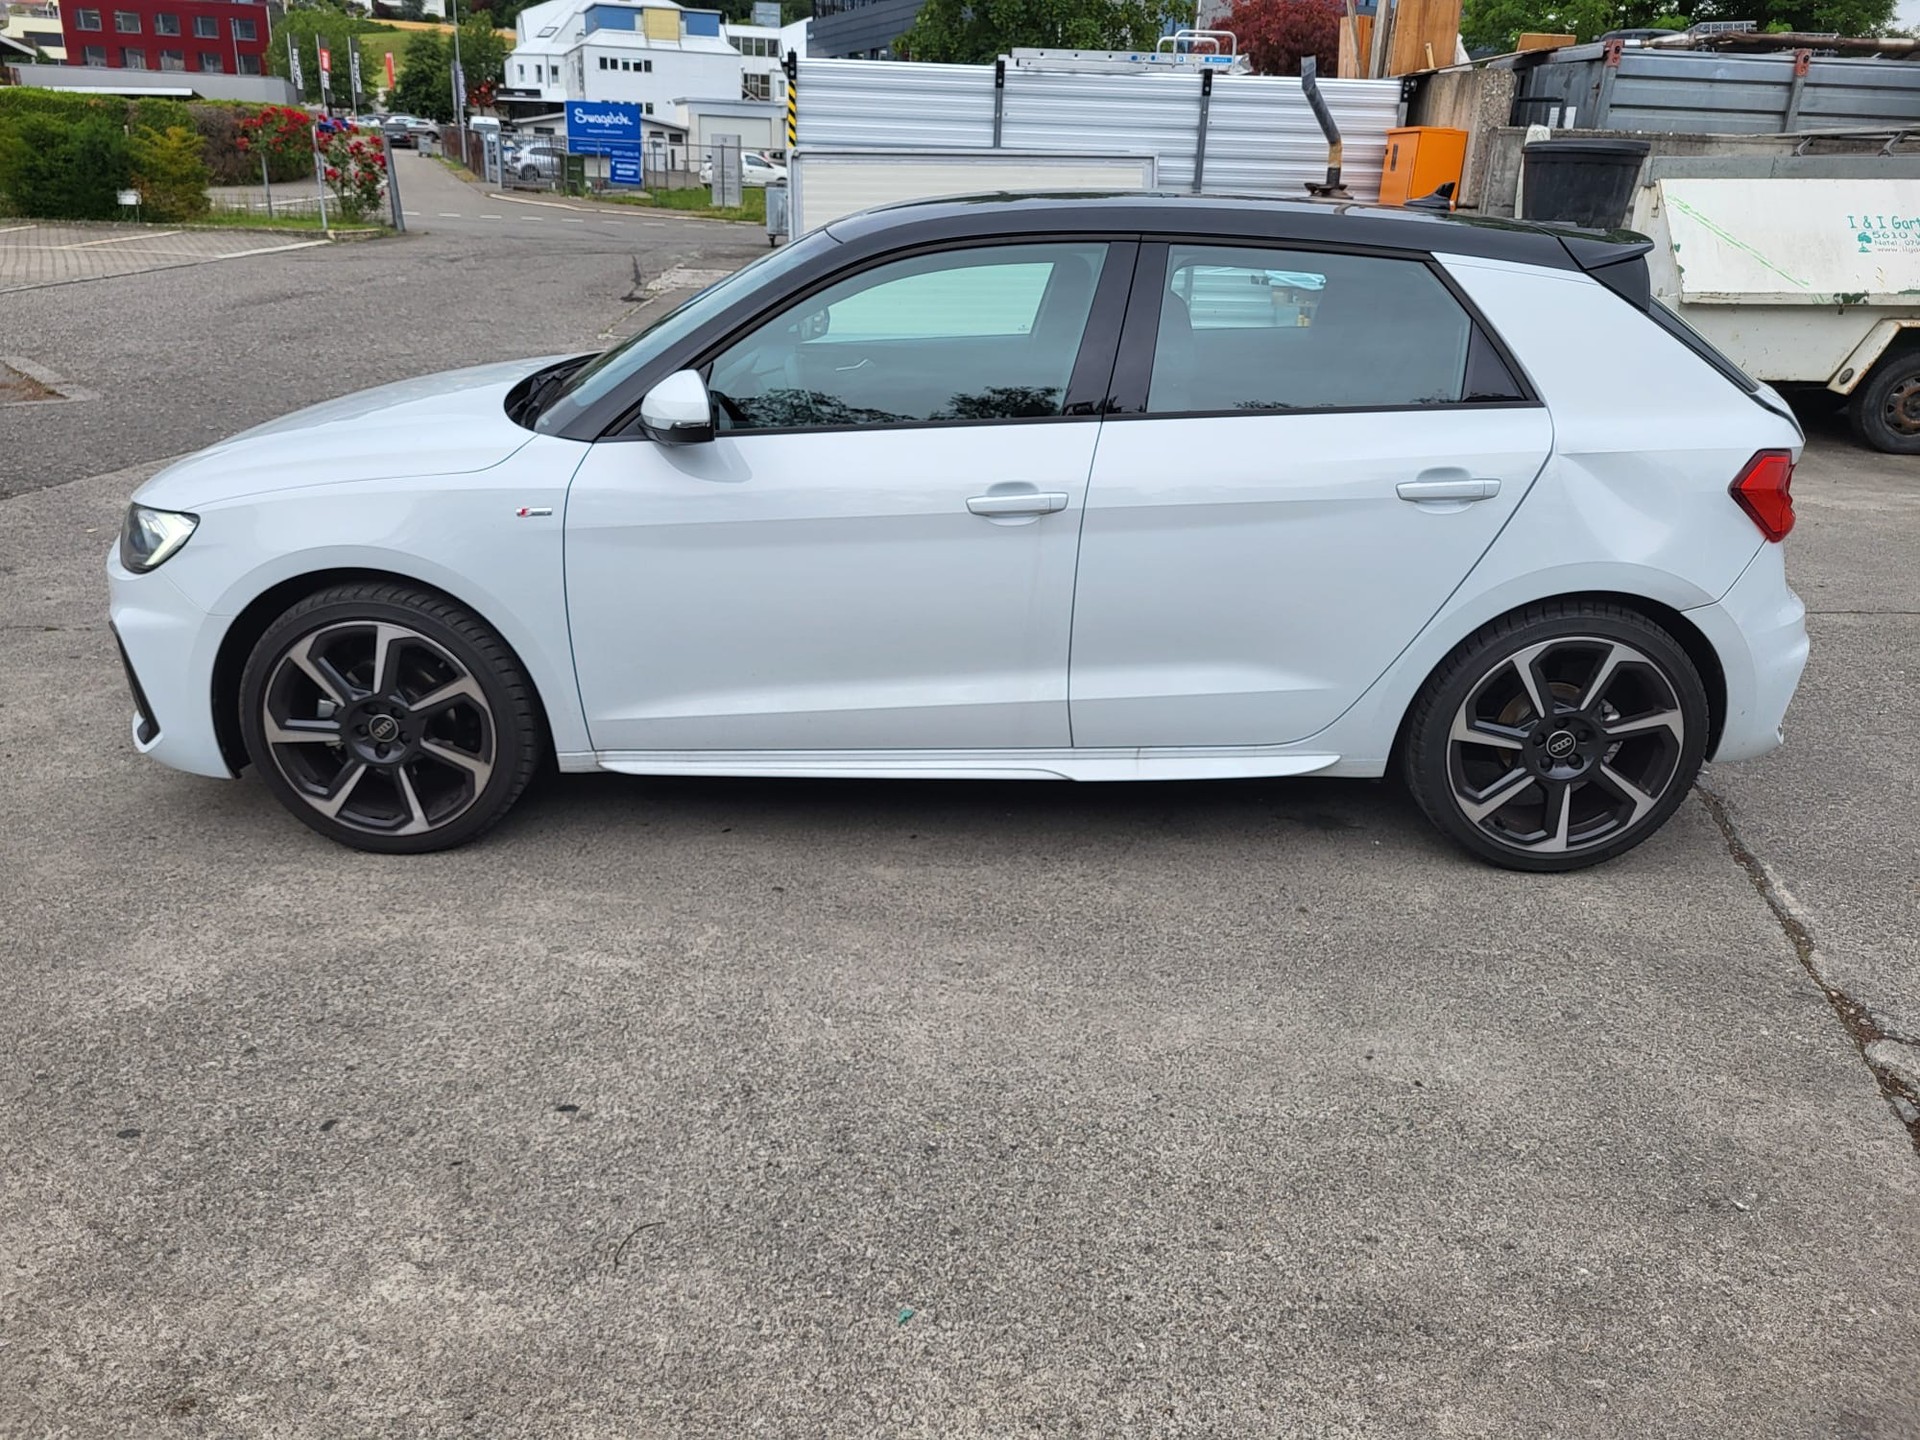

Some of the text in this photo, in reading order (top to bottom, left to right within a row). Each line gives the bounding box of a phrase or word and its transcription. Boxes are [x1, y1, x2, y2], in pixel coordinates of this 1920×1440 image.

[1847, 215, 1857, 229] I
[1863, 215, 1873, 229] &
[1876, 215, 1887, 229] I
[1872, 231, 1908, 239] 5610
